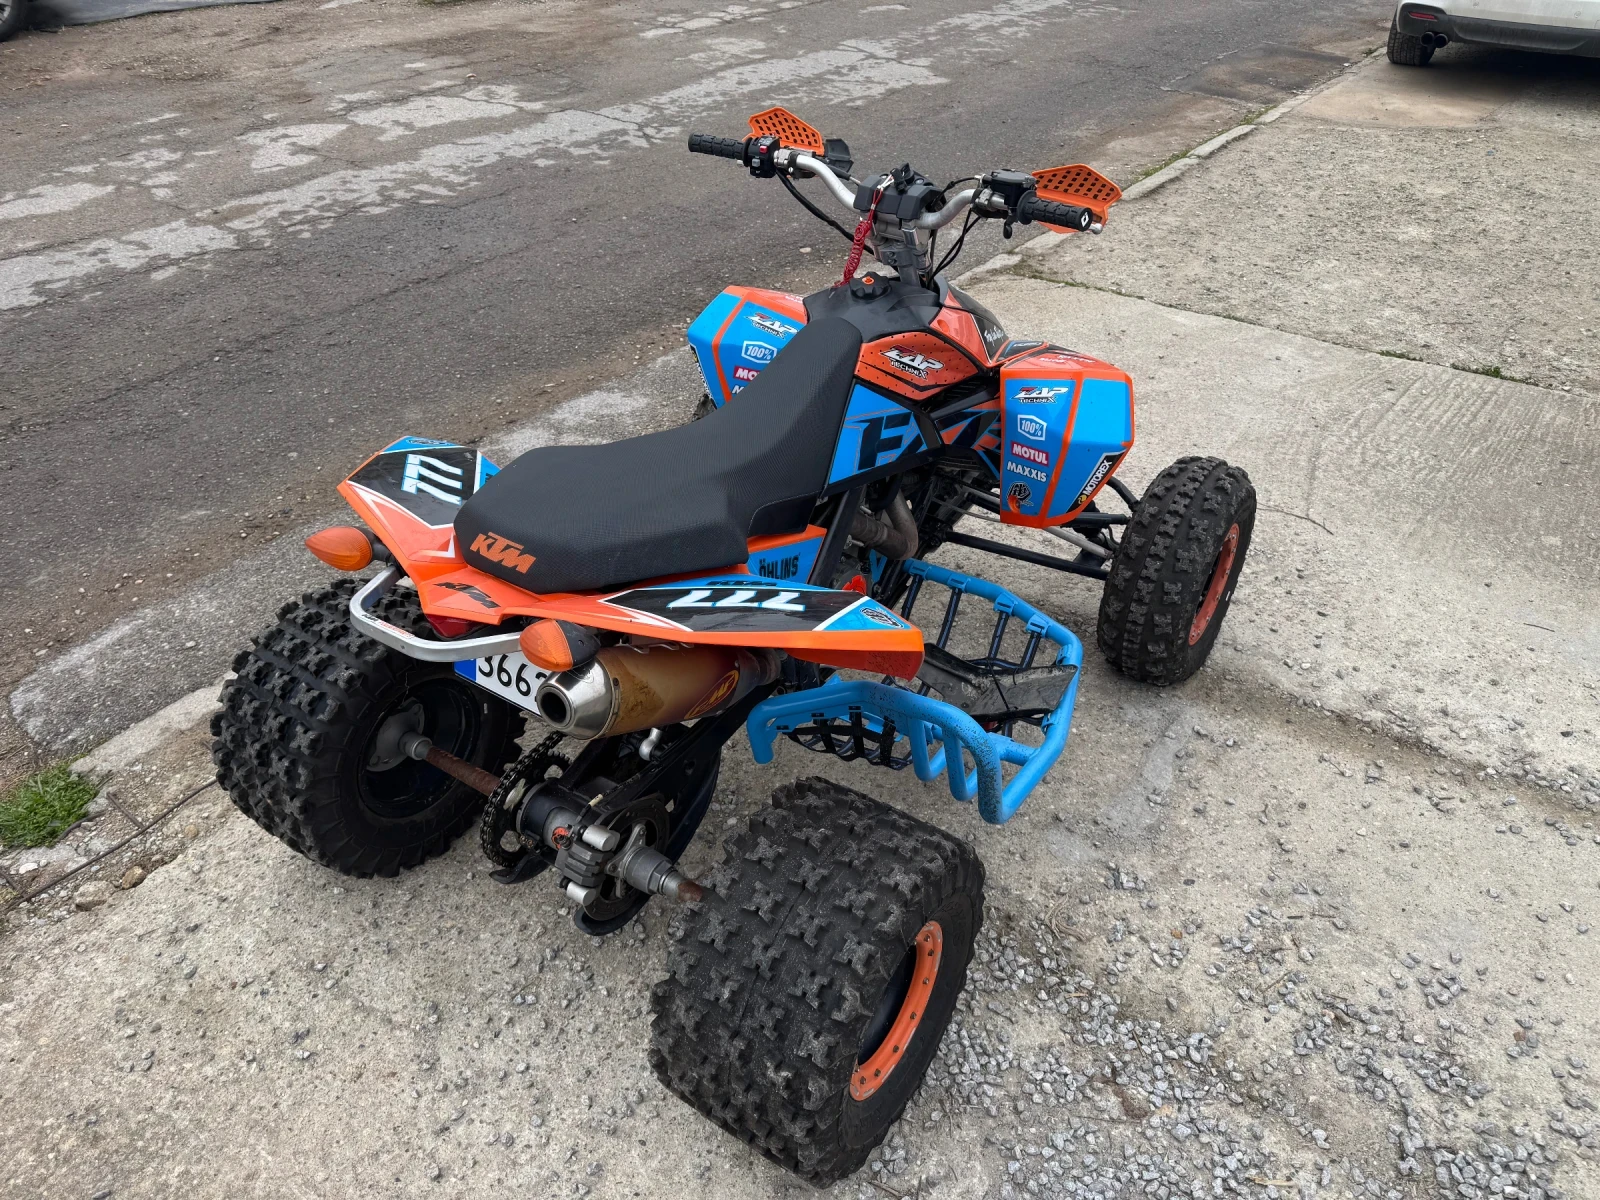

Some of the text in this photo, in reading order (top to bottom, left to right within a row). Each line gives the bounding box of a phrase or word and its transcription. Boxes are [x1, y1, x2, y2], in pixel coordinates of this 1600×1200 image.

[745, 345, 772, 361] 100%
[881, 345, 944, 370] ZAP
[1012, 386, 1069, 399] ZAP
[1022, 420, 1042, 437] 100%
[1012, 444, 1048, 465] MOTUL
[1007, 461, 1047, 482] MAXXIS
[1083, 460, 1114, 497] MOTOREX
[470, 531, 537, 575] KTM
[759, 554, 799, 581] ÖHLINS
[432, 581, 502, 609] KTM
